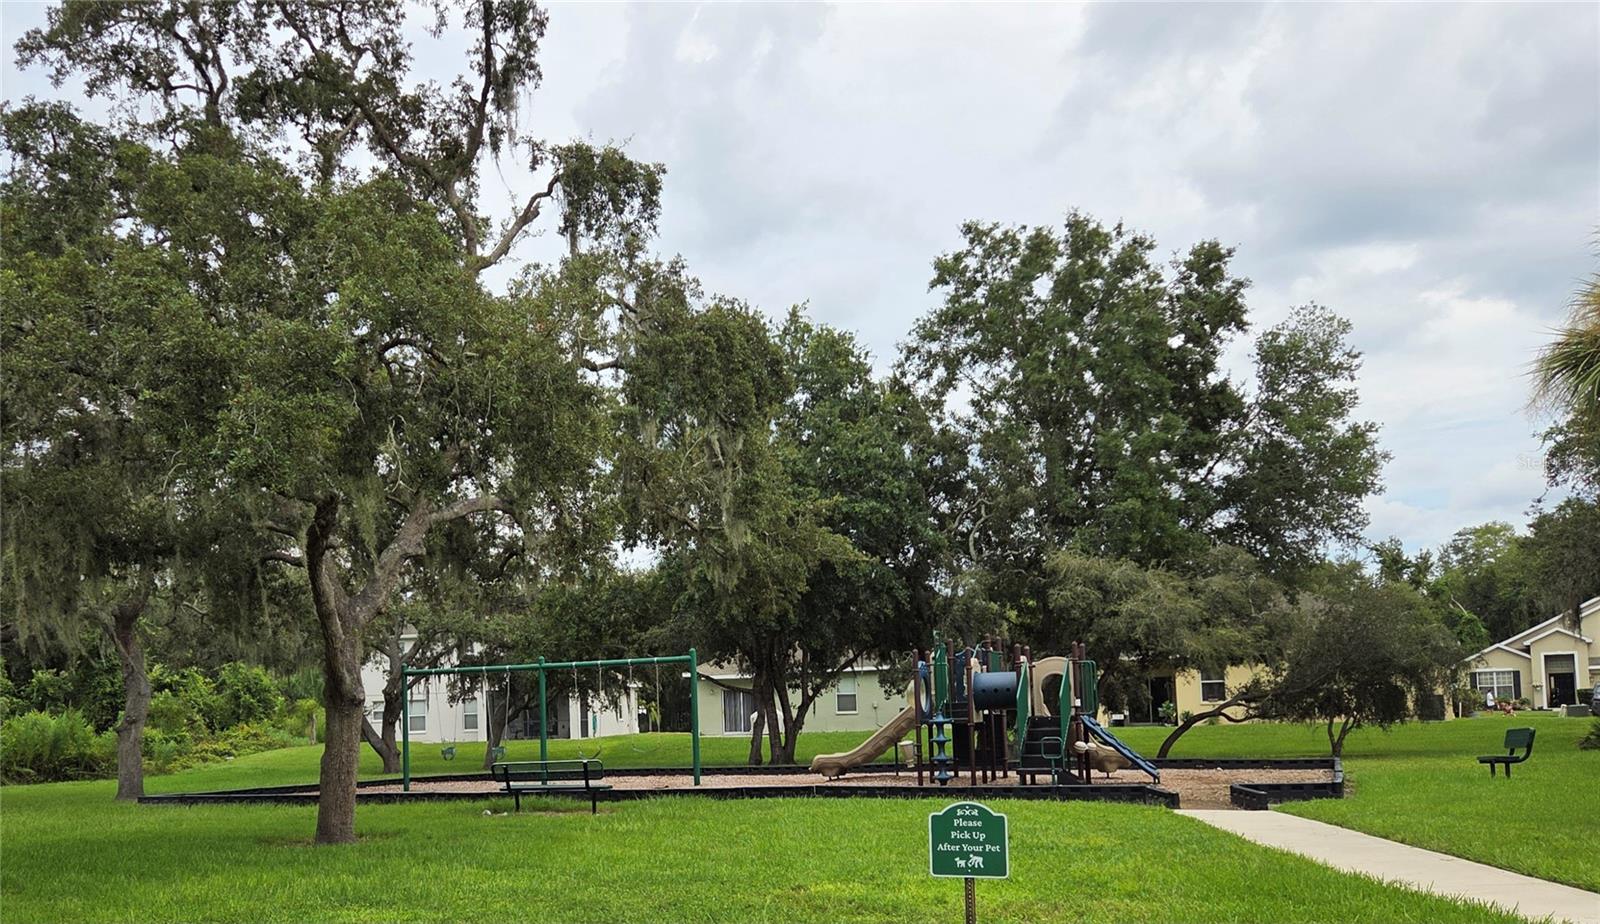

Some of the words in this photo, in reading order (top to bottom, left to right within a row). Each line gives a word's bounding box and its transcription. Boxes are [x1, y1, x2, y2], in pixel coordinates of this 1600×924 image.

[953, 818, 983, 827] Please
[950, 830, 971, 839] Pick
[972, 831, 986, 841] Up
[937, 842, 960, 852] After
[961, 843, 984, 852] Your
[985, 844, 1001, 852] Pet
